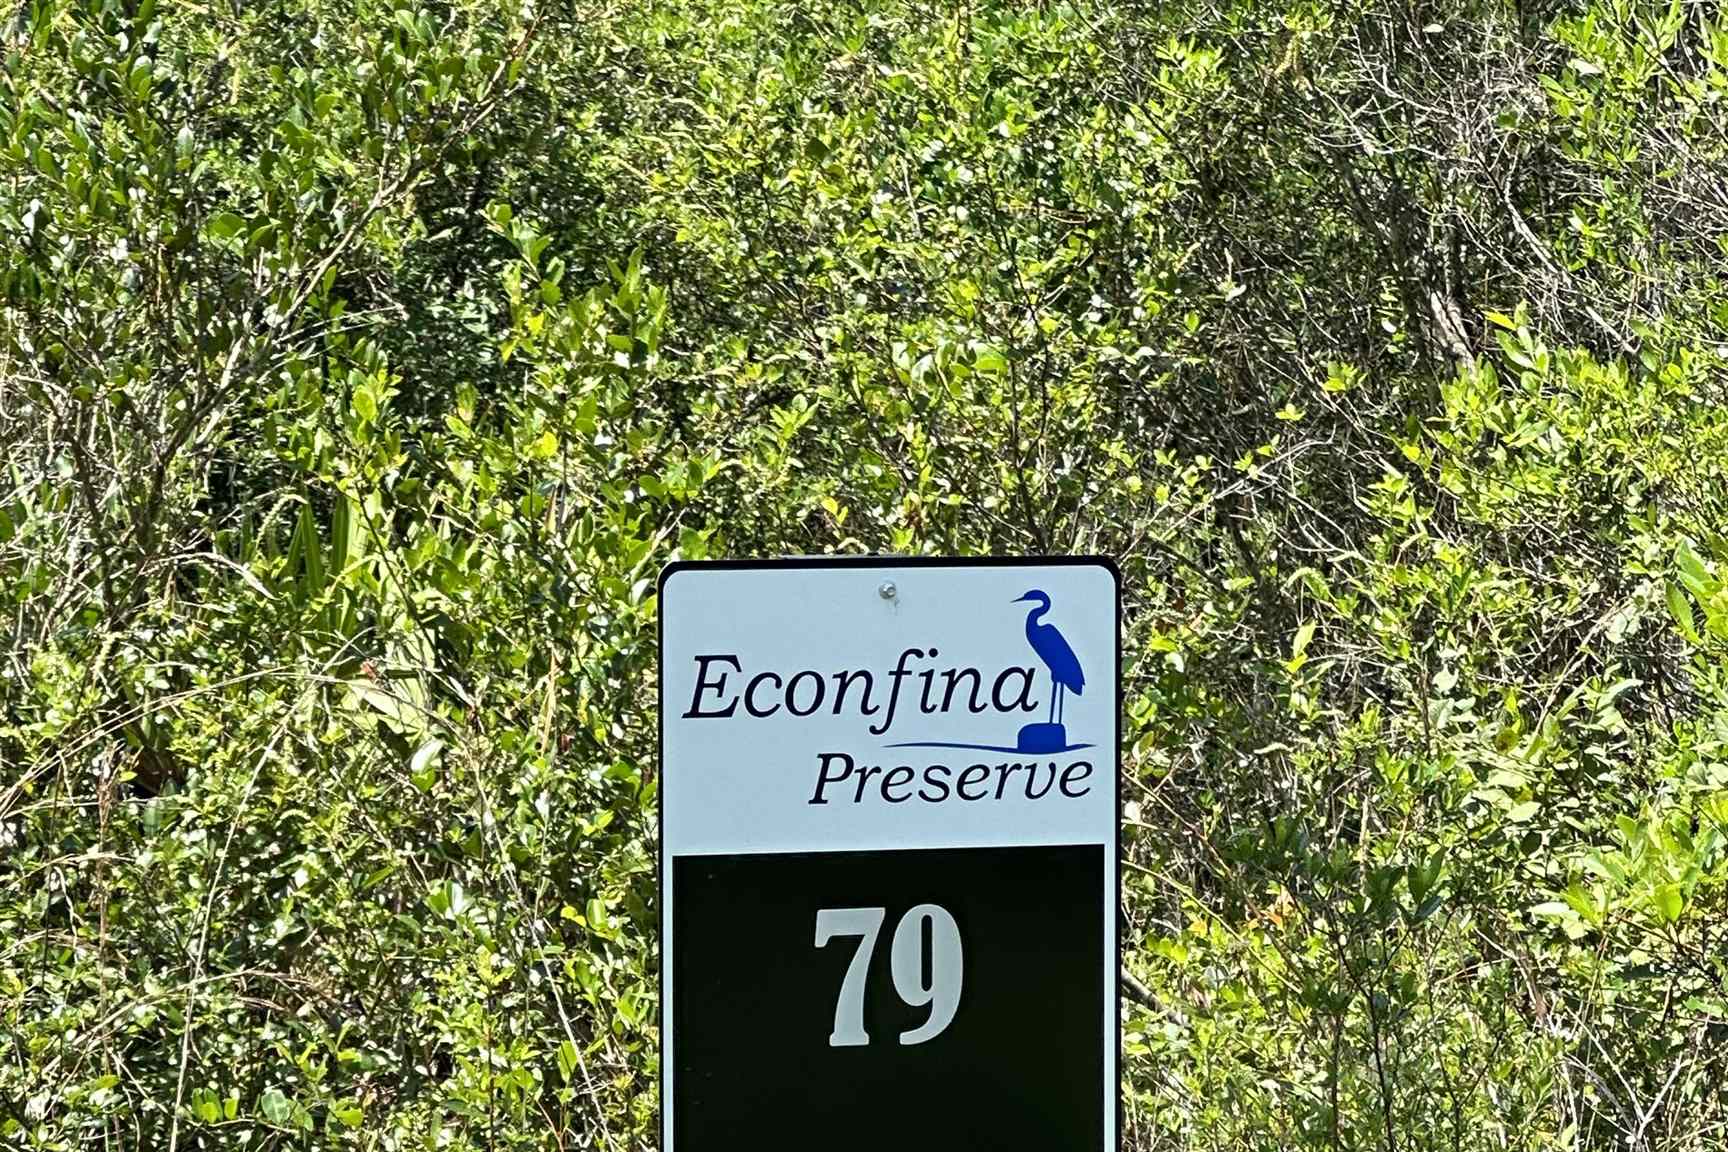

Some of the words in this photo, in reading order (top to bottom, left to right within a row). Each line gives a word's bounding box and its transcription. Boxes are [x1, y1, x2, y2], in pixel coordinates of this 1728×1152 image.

[682, 648, 1039, 735] Econfina
[808, 753, 1093, 805] Preserve
[815, 904, 964, 1046] 79
